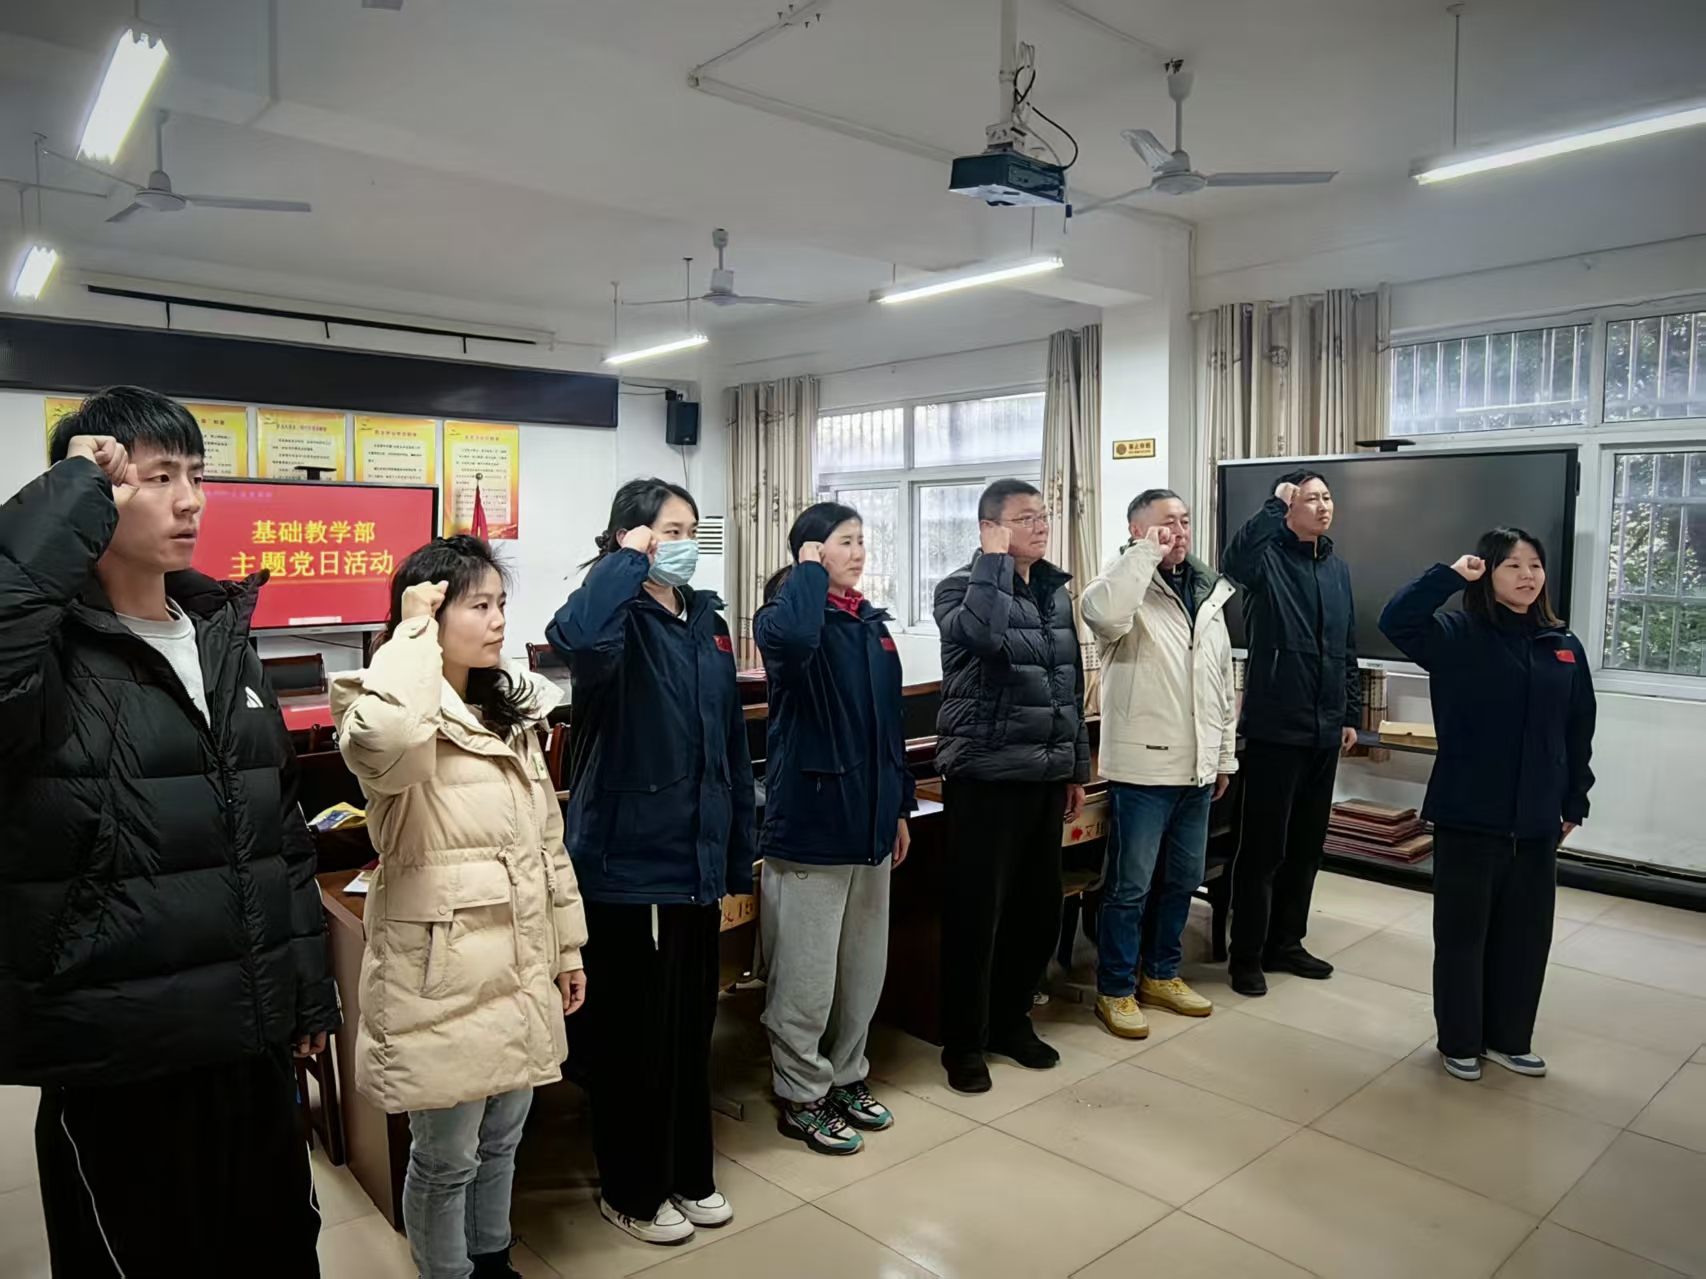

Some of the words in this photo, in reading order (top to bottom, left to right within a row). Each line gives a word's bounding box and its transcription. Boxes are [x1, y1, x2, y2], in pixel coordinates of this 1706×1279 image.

[252, 520, 376, 544] 基础教学部
[228, 549, 394, 578] 主题党日活动
